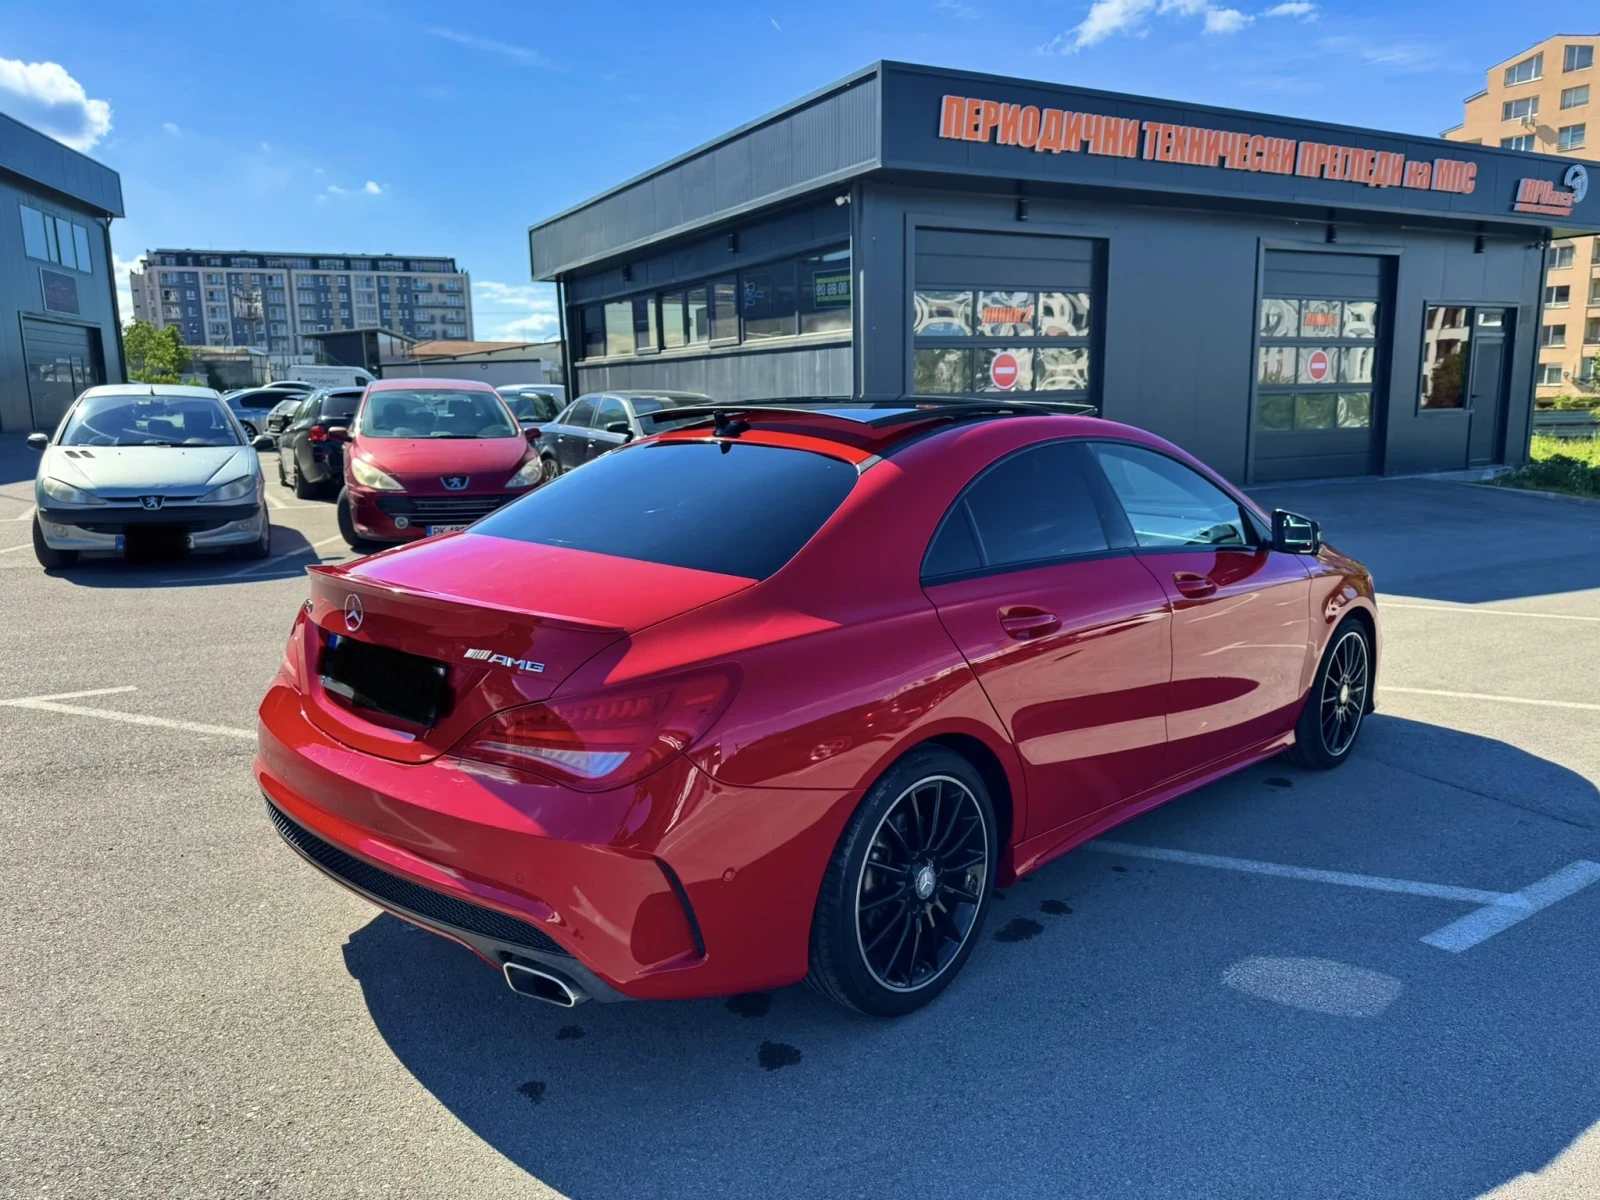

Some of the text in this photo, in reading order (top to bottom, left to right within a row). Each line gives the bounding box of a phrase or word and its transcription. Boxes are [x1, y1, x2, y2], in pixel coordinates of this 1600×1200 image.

[939, 95, 1477, 194] ПЕРИОДИЧНИ ТЕХНИЧЕСКИ ПРЕГЛЕДИ на МПС
[488, 654, 545, 673] AMG
